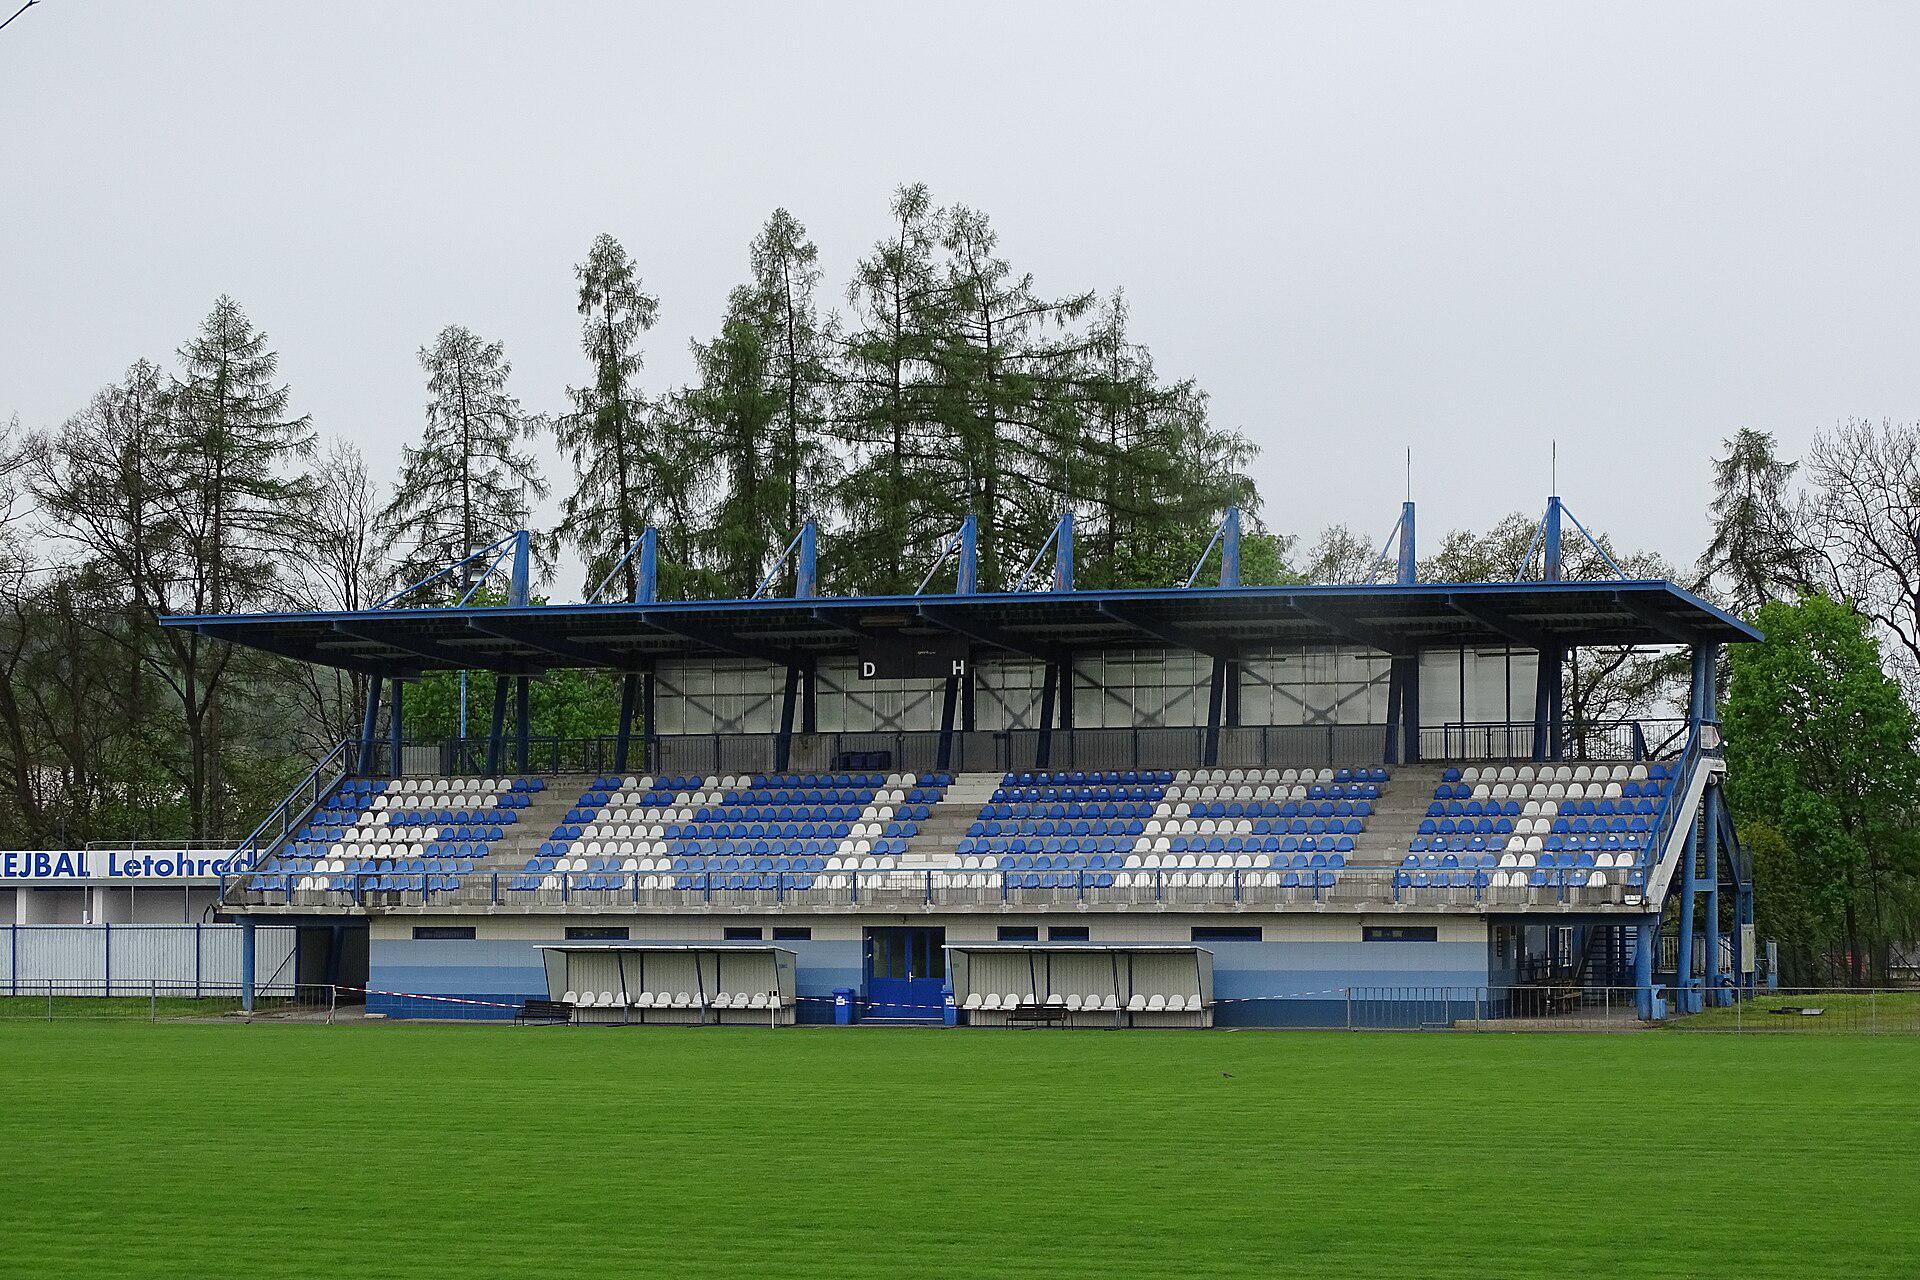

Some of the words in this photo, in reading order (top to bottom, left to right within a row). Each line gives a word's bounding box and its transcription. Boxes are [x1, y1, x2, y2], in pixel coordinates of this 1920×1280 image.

[863, 662, 876, 677] D
[952, 660, 965, 675] H
[0, 852, 91, 877] EJBAL
